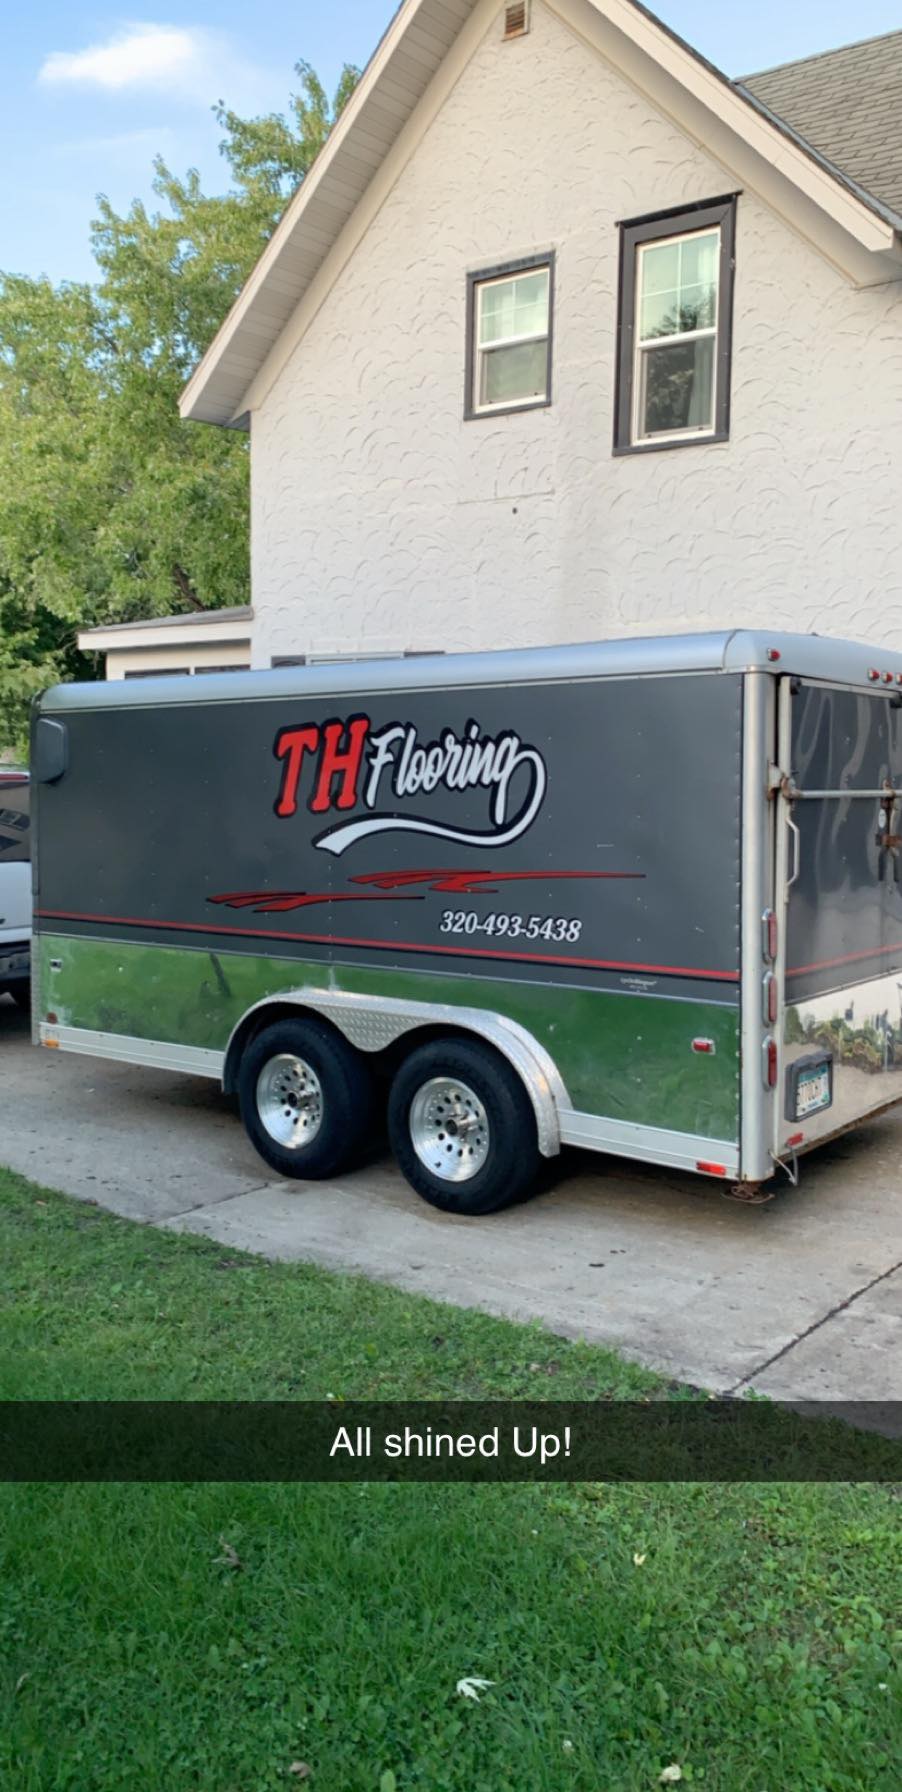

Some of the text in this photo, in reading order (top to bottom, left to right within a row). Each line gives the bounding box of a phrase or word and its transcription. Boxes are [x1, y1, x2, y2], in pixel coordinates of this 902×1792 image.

[277, 718, 546, 826] TH Flooring
[440, 910, 582, 942] 320-493-5438
